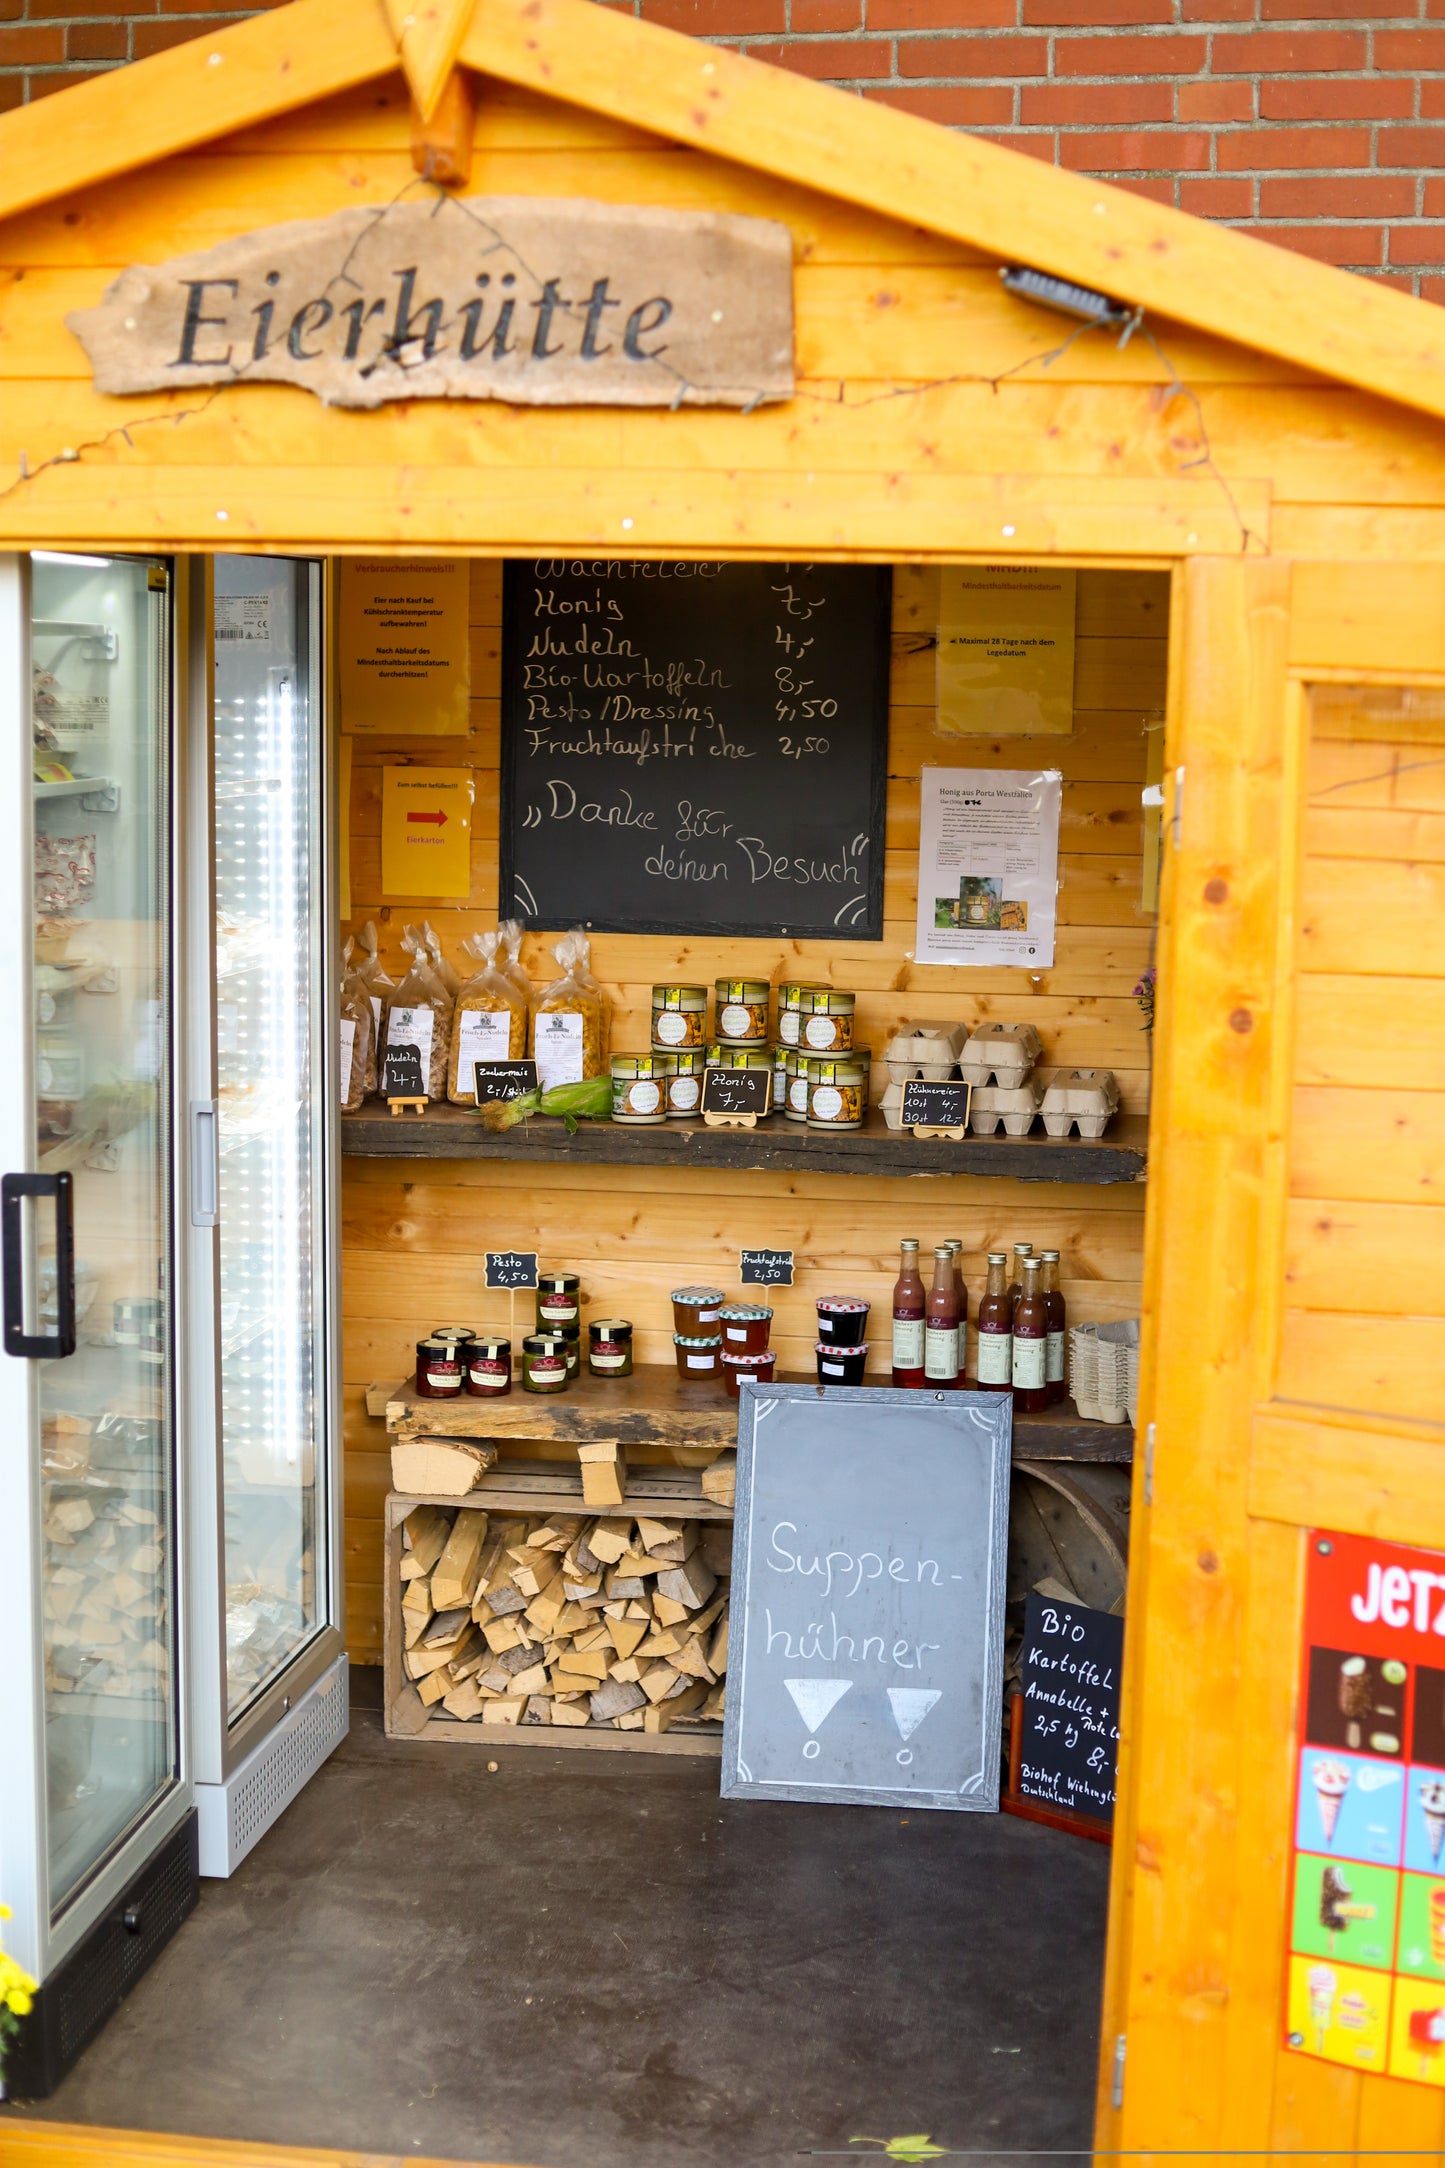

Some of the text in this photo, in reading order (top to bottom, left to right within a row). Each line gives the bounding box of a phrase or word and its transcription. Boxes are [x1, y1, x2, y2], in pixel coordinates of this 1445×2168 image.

[167, 266, 673, 367] Eierhütte
[355, 563, 455, 574] Verbraucherhinweis!!!
[962, 582, 1061, 591] Mindesthaltbarkeitsdatum
[363, 608, 444, 616] Kühlschranktemperatur
[534, 588, 624, 620] Honig
[380, 620, 427, 628] aufbewahren!
[526, 624, 641, 657] Nudeln
[959, 637, 990, 645] Maximal
[991, 637, 1001, 645] 28
[1002, 638, 1019, 647] Tage
[987, 649, 1026, 657] Legedatum
[356, 659, 450, 667] Mindesthaltbarkeitsdatums
[776, 699, 838, 722] 4,50
[778, 736, 830, 760] 2,50
[939, 788, 960, 797] Honig
[975, 789, 995, 797] Porta
[406, 836, 445, 844] Eierkarton
[645, 844, 729, 882] deinen
[385, 1051, 418, 1063] Nudeln
[711, 1073, 755, 1090] Honig
[492, 1254, 522, 1268] Pesto
[497, 1271, 529, 1283] 4,50
[754, 1269, 781, 1281] 2,50
[766, 1521, 963, 1597] Suppen-
[1041, 1608, 1085, 1642] Bio
[765, 1608, 940, 1670] hühner
[1025, 1681, 1093, 1716] Annabelle
[1034, 1715, 1079, 1748] 2,5 kg
[1080, 1716, 1107, 1736] Rote
[1021, 1763, 1061, 1790] Biohof
